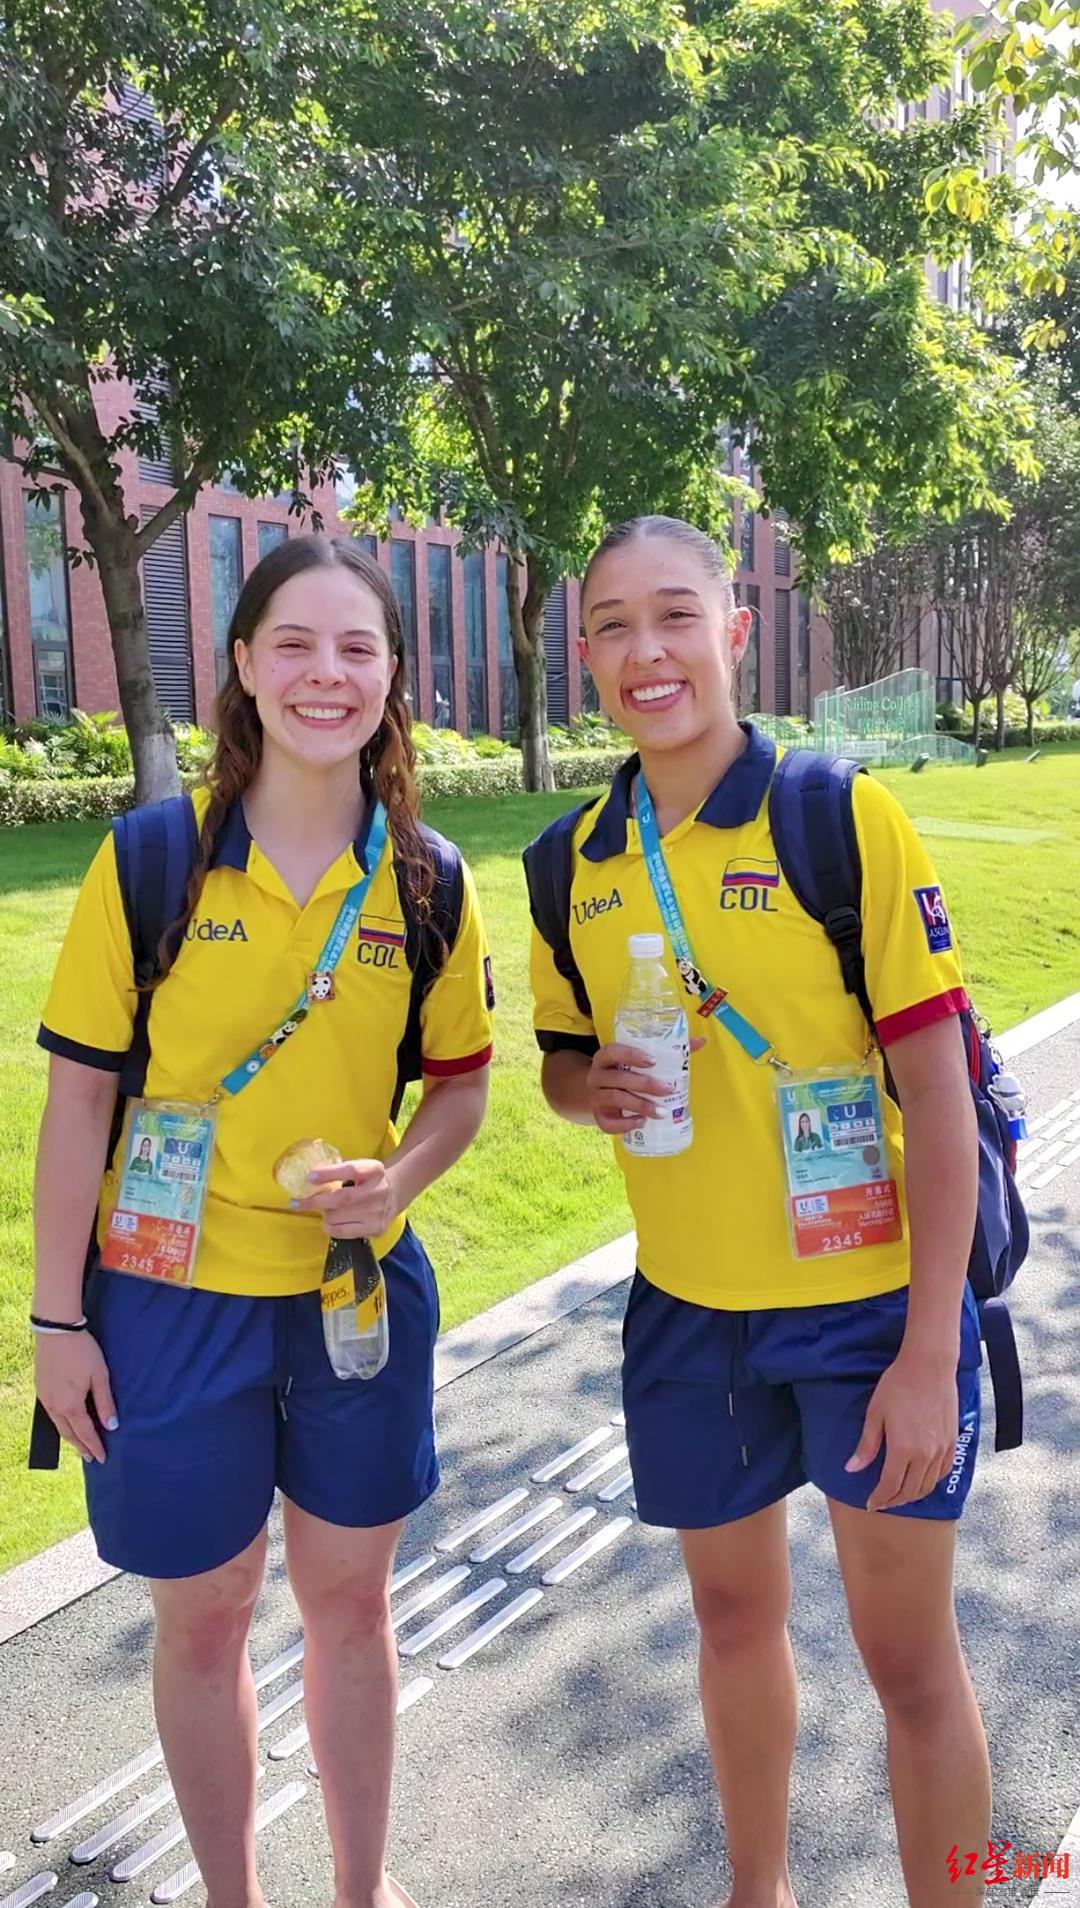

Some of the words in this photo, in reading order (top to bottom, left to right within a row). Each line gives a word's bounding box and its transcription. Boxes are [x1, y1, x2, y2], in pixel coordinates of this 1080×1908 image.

[572, 888, 624, 926] UdeA
[720, 886, 778, 912] COL
[184, 918, 248, 942] UdeA
[357, 942, 399, 969] COL
[822, 1232, 863, 1251] 2345
[121, 1254, 154, 1273] 2345
[946, 1421, 975, 1494] COLOMBIA
